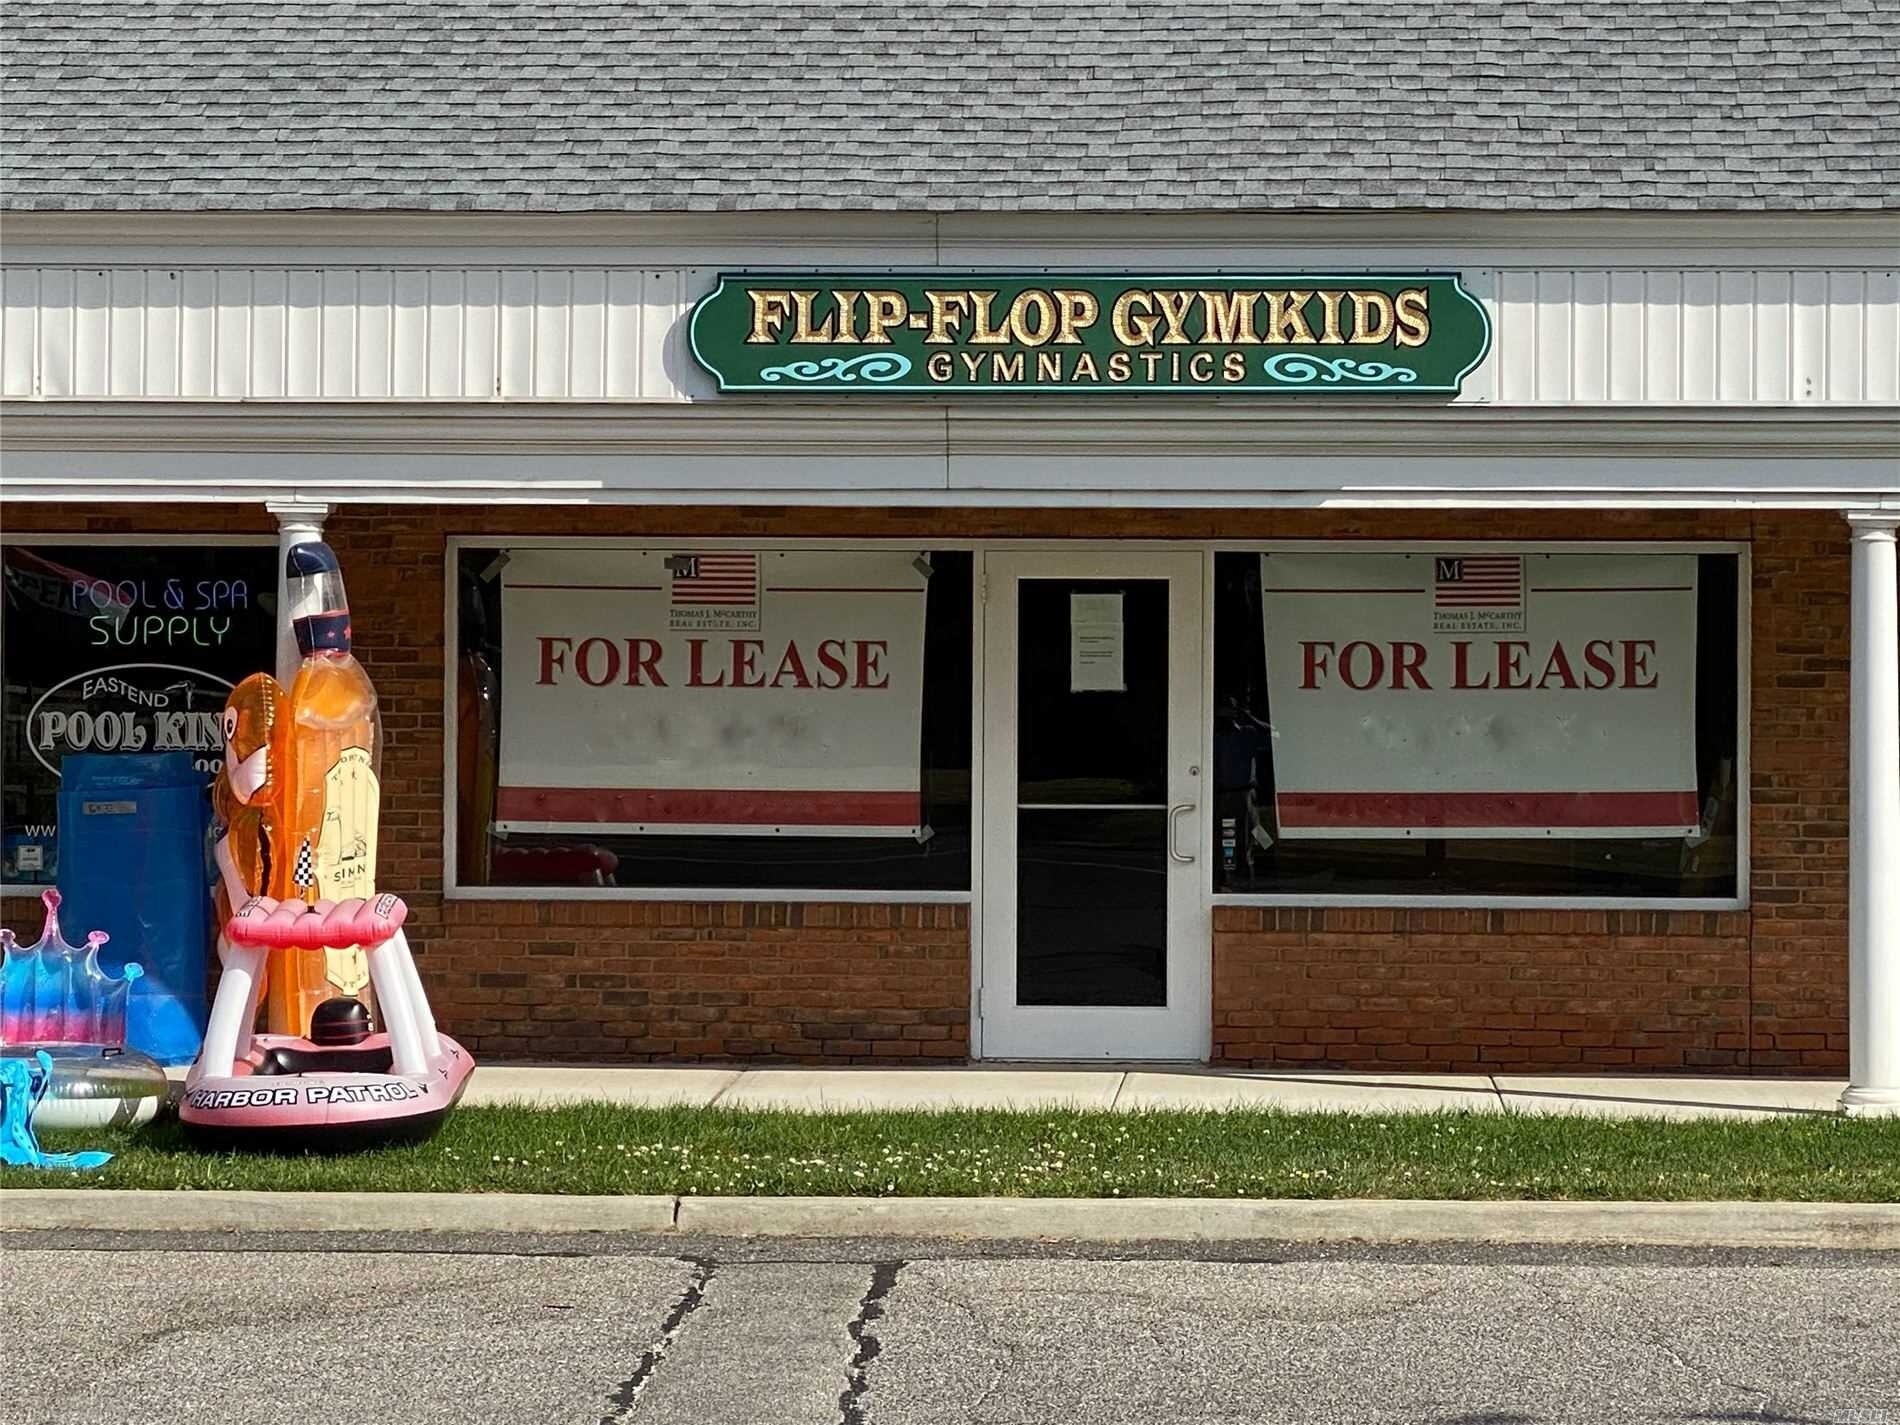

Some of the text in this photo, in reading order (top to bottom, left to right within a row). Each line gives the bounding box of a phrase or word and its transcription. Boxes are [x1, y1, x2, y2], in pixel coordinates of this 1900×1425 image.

[745, 287, 1431, 347] FLIP-FLOP GYMKIDS
[926, 351, 1248, 383] GYMNASTICS
[1439, 559, 1460, 580] M
[72, 579, 157, 610] POOL
[163, 579, 184, 610] &
[196, 579, 249, 610] SPA
[90, 615, 231, 647] SUPPLY
[535, 636, 891, 690] FOR LEASE
[1298, 639, 1660, 691] FOR LEASE
[82, 677, 169, 708] EASTEND
[38, 710, 225, 751] POOL KIN
[191, 1082, 418, 1110] HARBOR PATROL
